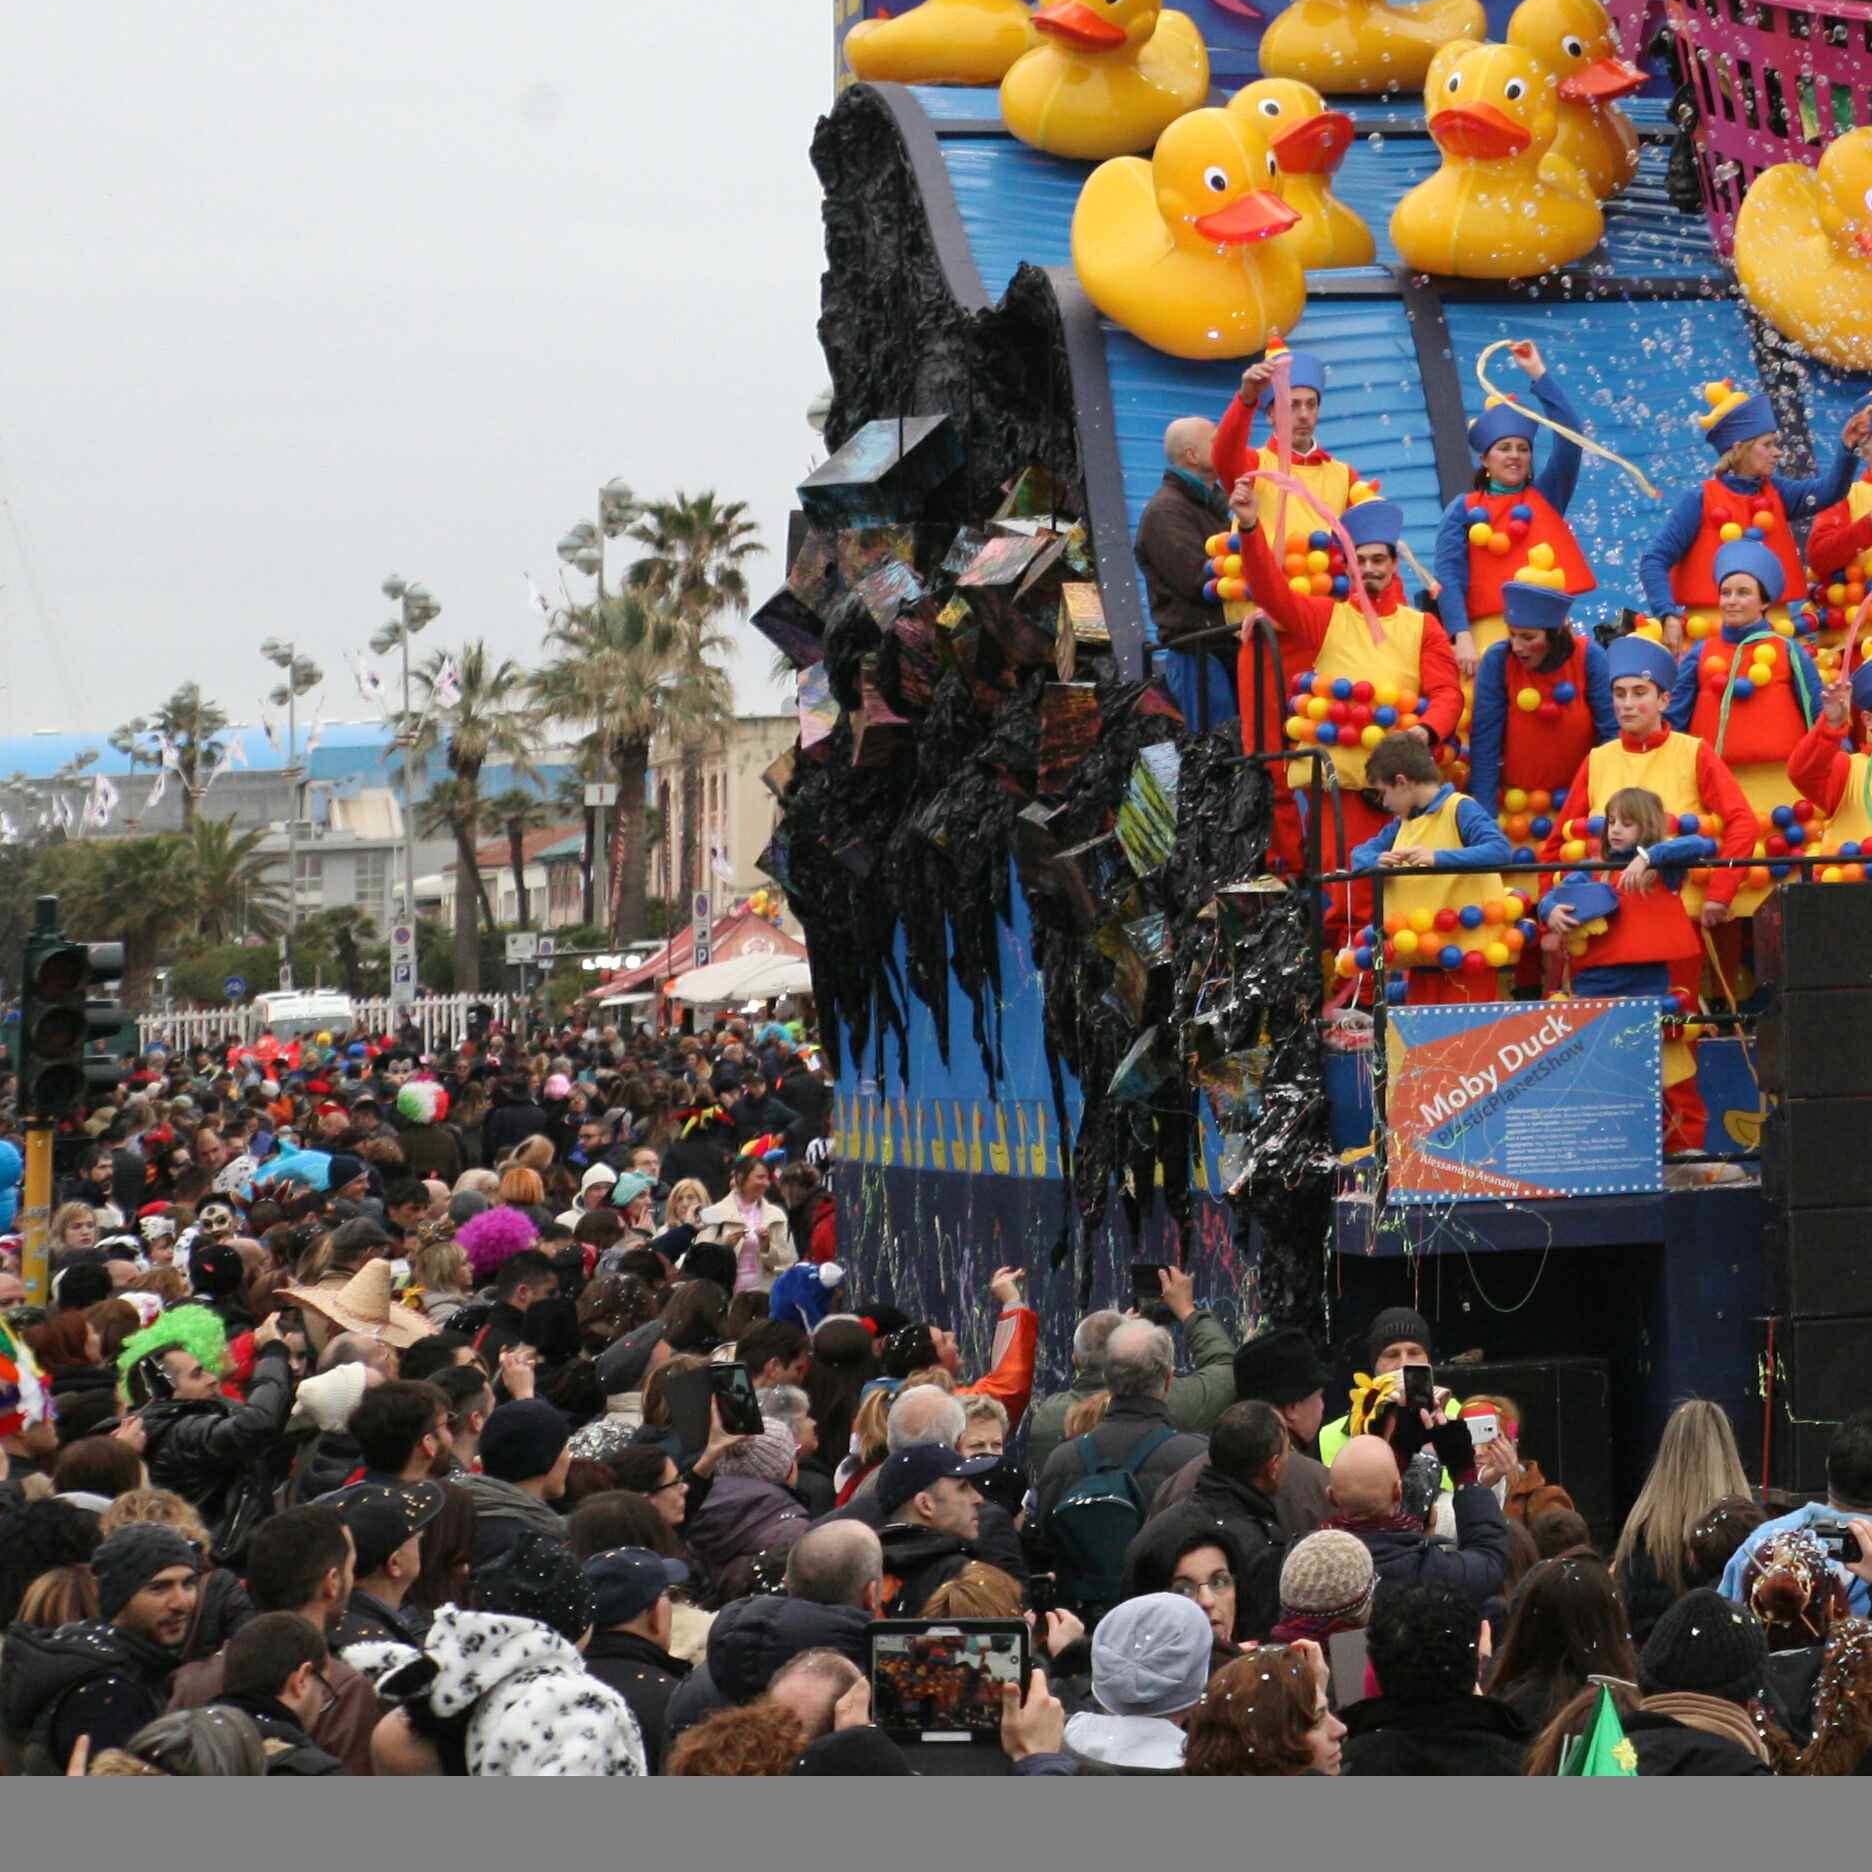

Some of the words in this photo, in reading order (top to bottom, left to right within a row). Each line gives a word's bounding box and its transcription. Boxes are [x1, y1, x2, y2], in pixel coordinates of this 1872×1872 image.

[1418, 1063, 1499, 1128] Moby
[1497, 1012, 1574, 1073] Duck
[1437, 1039, 1585, 1146] PlasticPlanetShow
[1419, 1153, 1475, 1178] Alessandro
[1475, 1169, 1520, 1191] Avanzini
